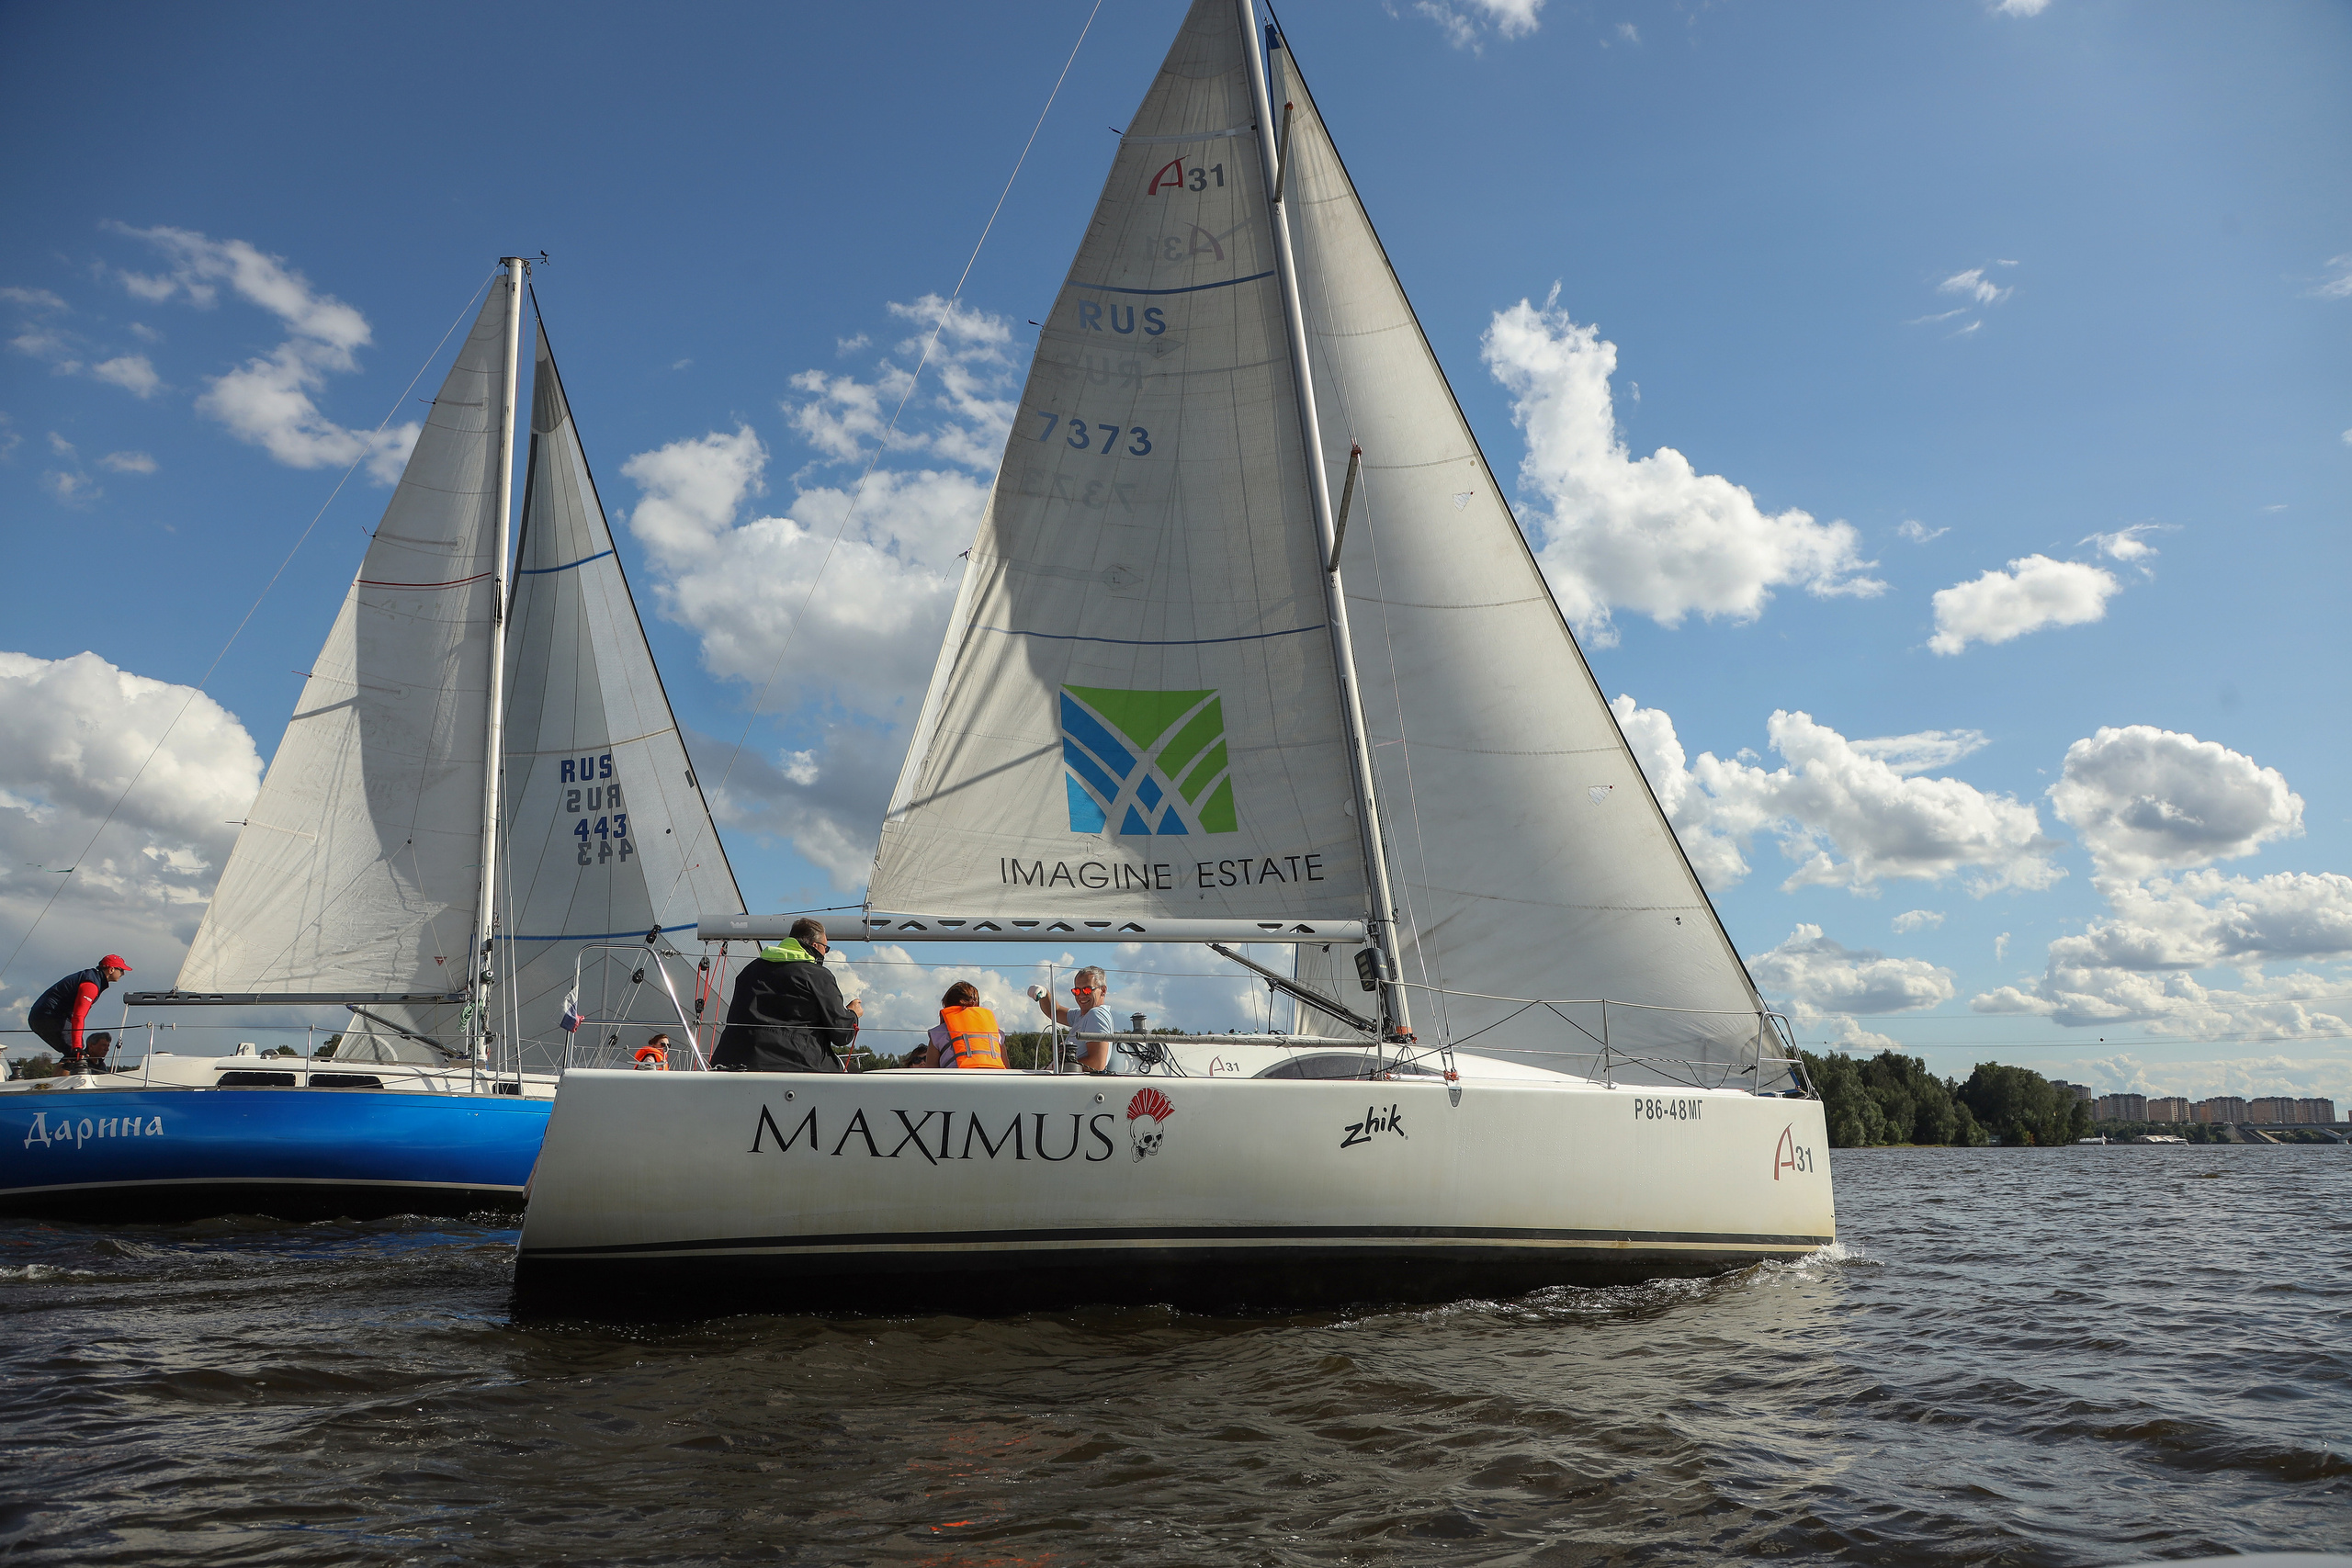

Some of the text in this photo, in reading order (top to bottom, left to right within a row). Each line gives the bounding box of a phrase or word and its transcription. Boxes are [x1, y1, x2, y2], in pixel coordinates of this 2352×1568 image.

[1148, 154, 1225, 196] A31
[1078, 299, 1167, 336] RUS
[1037, 411, 1152, 457] 7373
[560, 753, 613, 784] RUS
[573, 813, 627, 842] 443
[1001, 853, 1324, 890] IMAGINE ESTATE
[23, 1111, 164, 1150] Дарина
[747, 1103, 1115, 1167] MAXIMUS
[1340, 1103, 1405, 1149] zhik
[1773, 1122, 1814, 1181] A31
